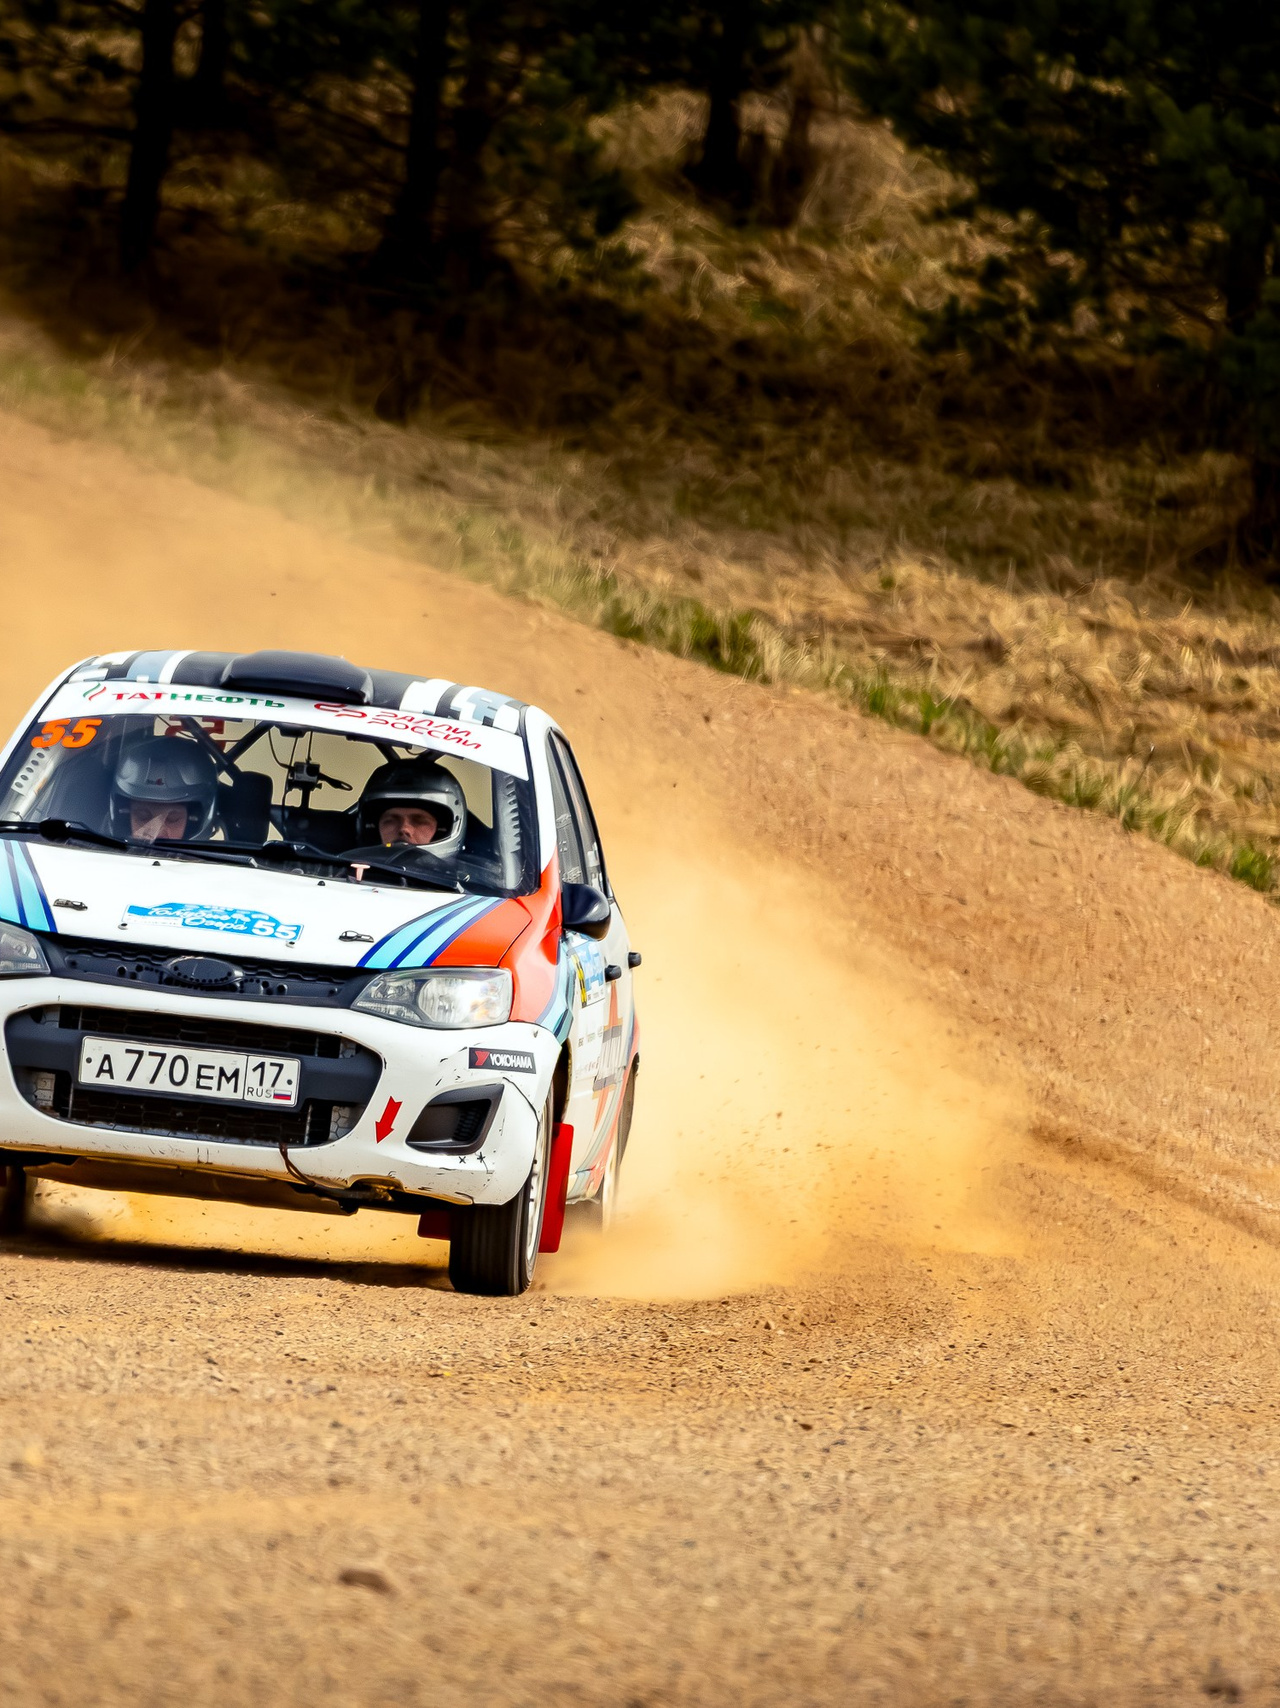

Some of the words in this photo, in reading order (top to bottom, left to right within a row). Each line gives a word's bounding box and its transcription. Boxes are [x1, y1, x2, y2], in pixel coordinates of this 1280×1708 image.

[111, 691, 285, 709] ТАТНЕФТЬ
[30, 718, 103, 749] 55
[367, 717, 482, 750] РОССИИ
[375, 710, 472, 737] РАЛЛИ
[250, 920, 298, 941] 55
[489, 1052, 533, 1069] YOKOHAMA
[251, 1061, 285, 1088] 17
[246, 1086, 273, 1099] RUS
